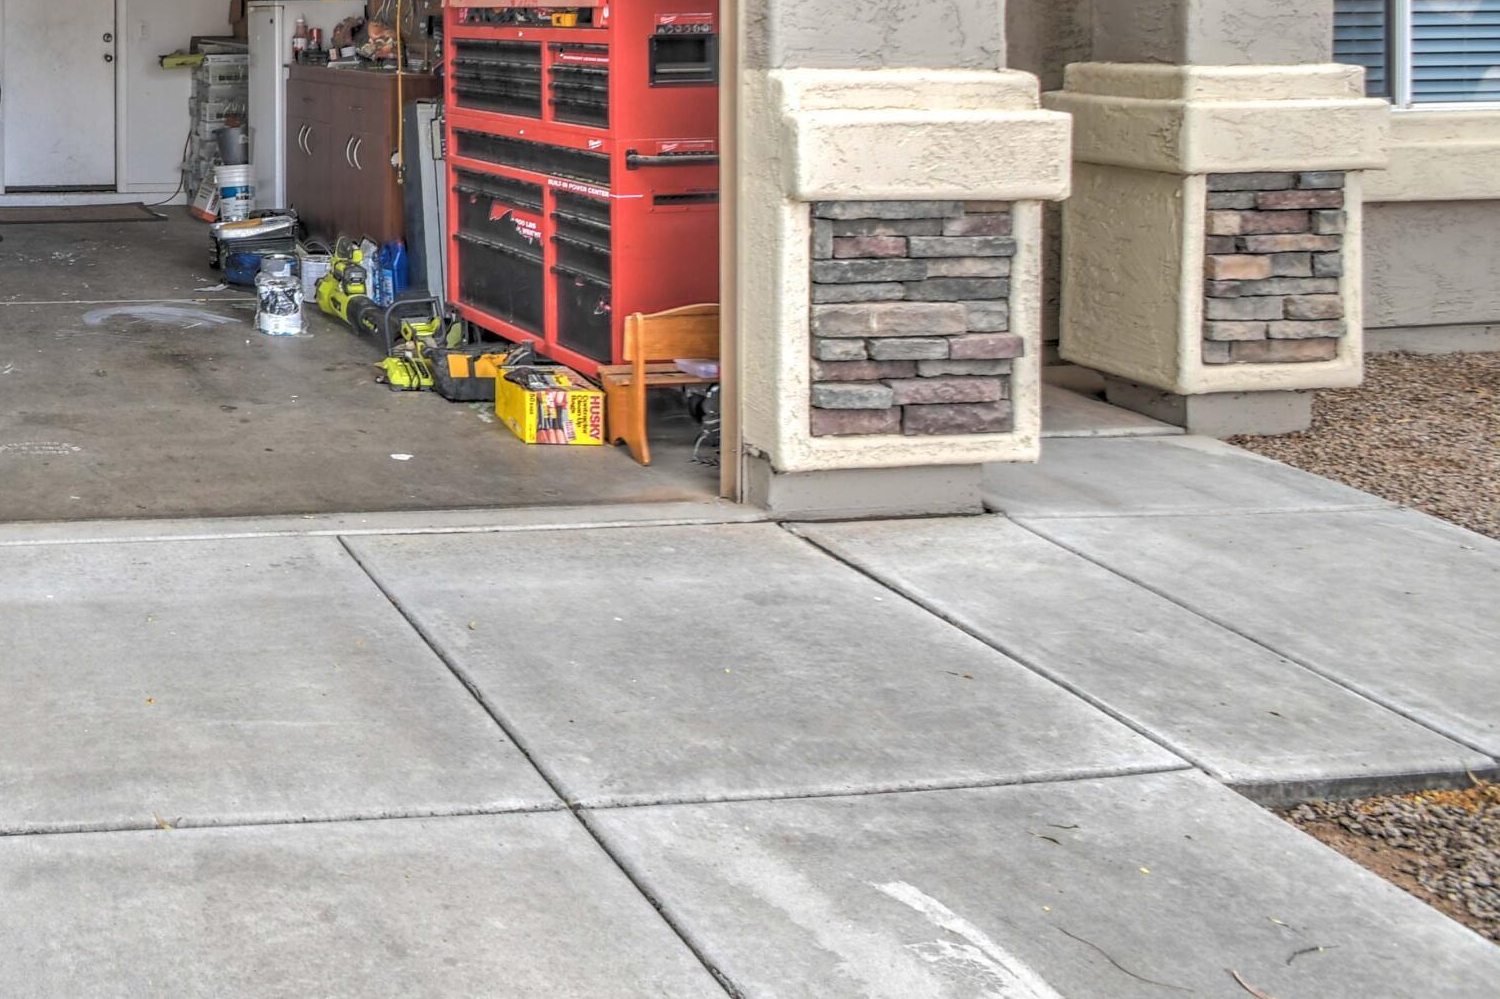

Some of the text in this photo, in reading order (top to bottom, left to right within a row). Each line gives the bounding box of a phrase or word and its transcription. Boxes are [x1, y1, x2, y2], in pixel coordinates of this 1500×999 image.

[568, 183, 587, 192] POWER
[587, 187, 610, 197] CENTER
[525, 221, 537, 229] LBS
[590, 396, 601, 440] HUSKY
